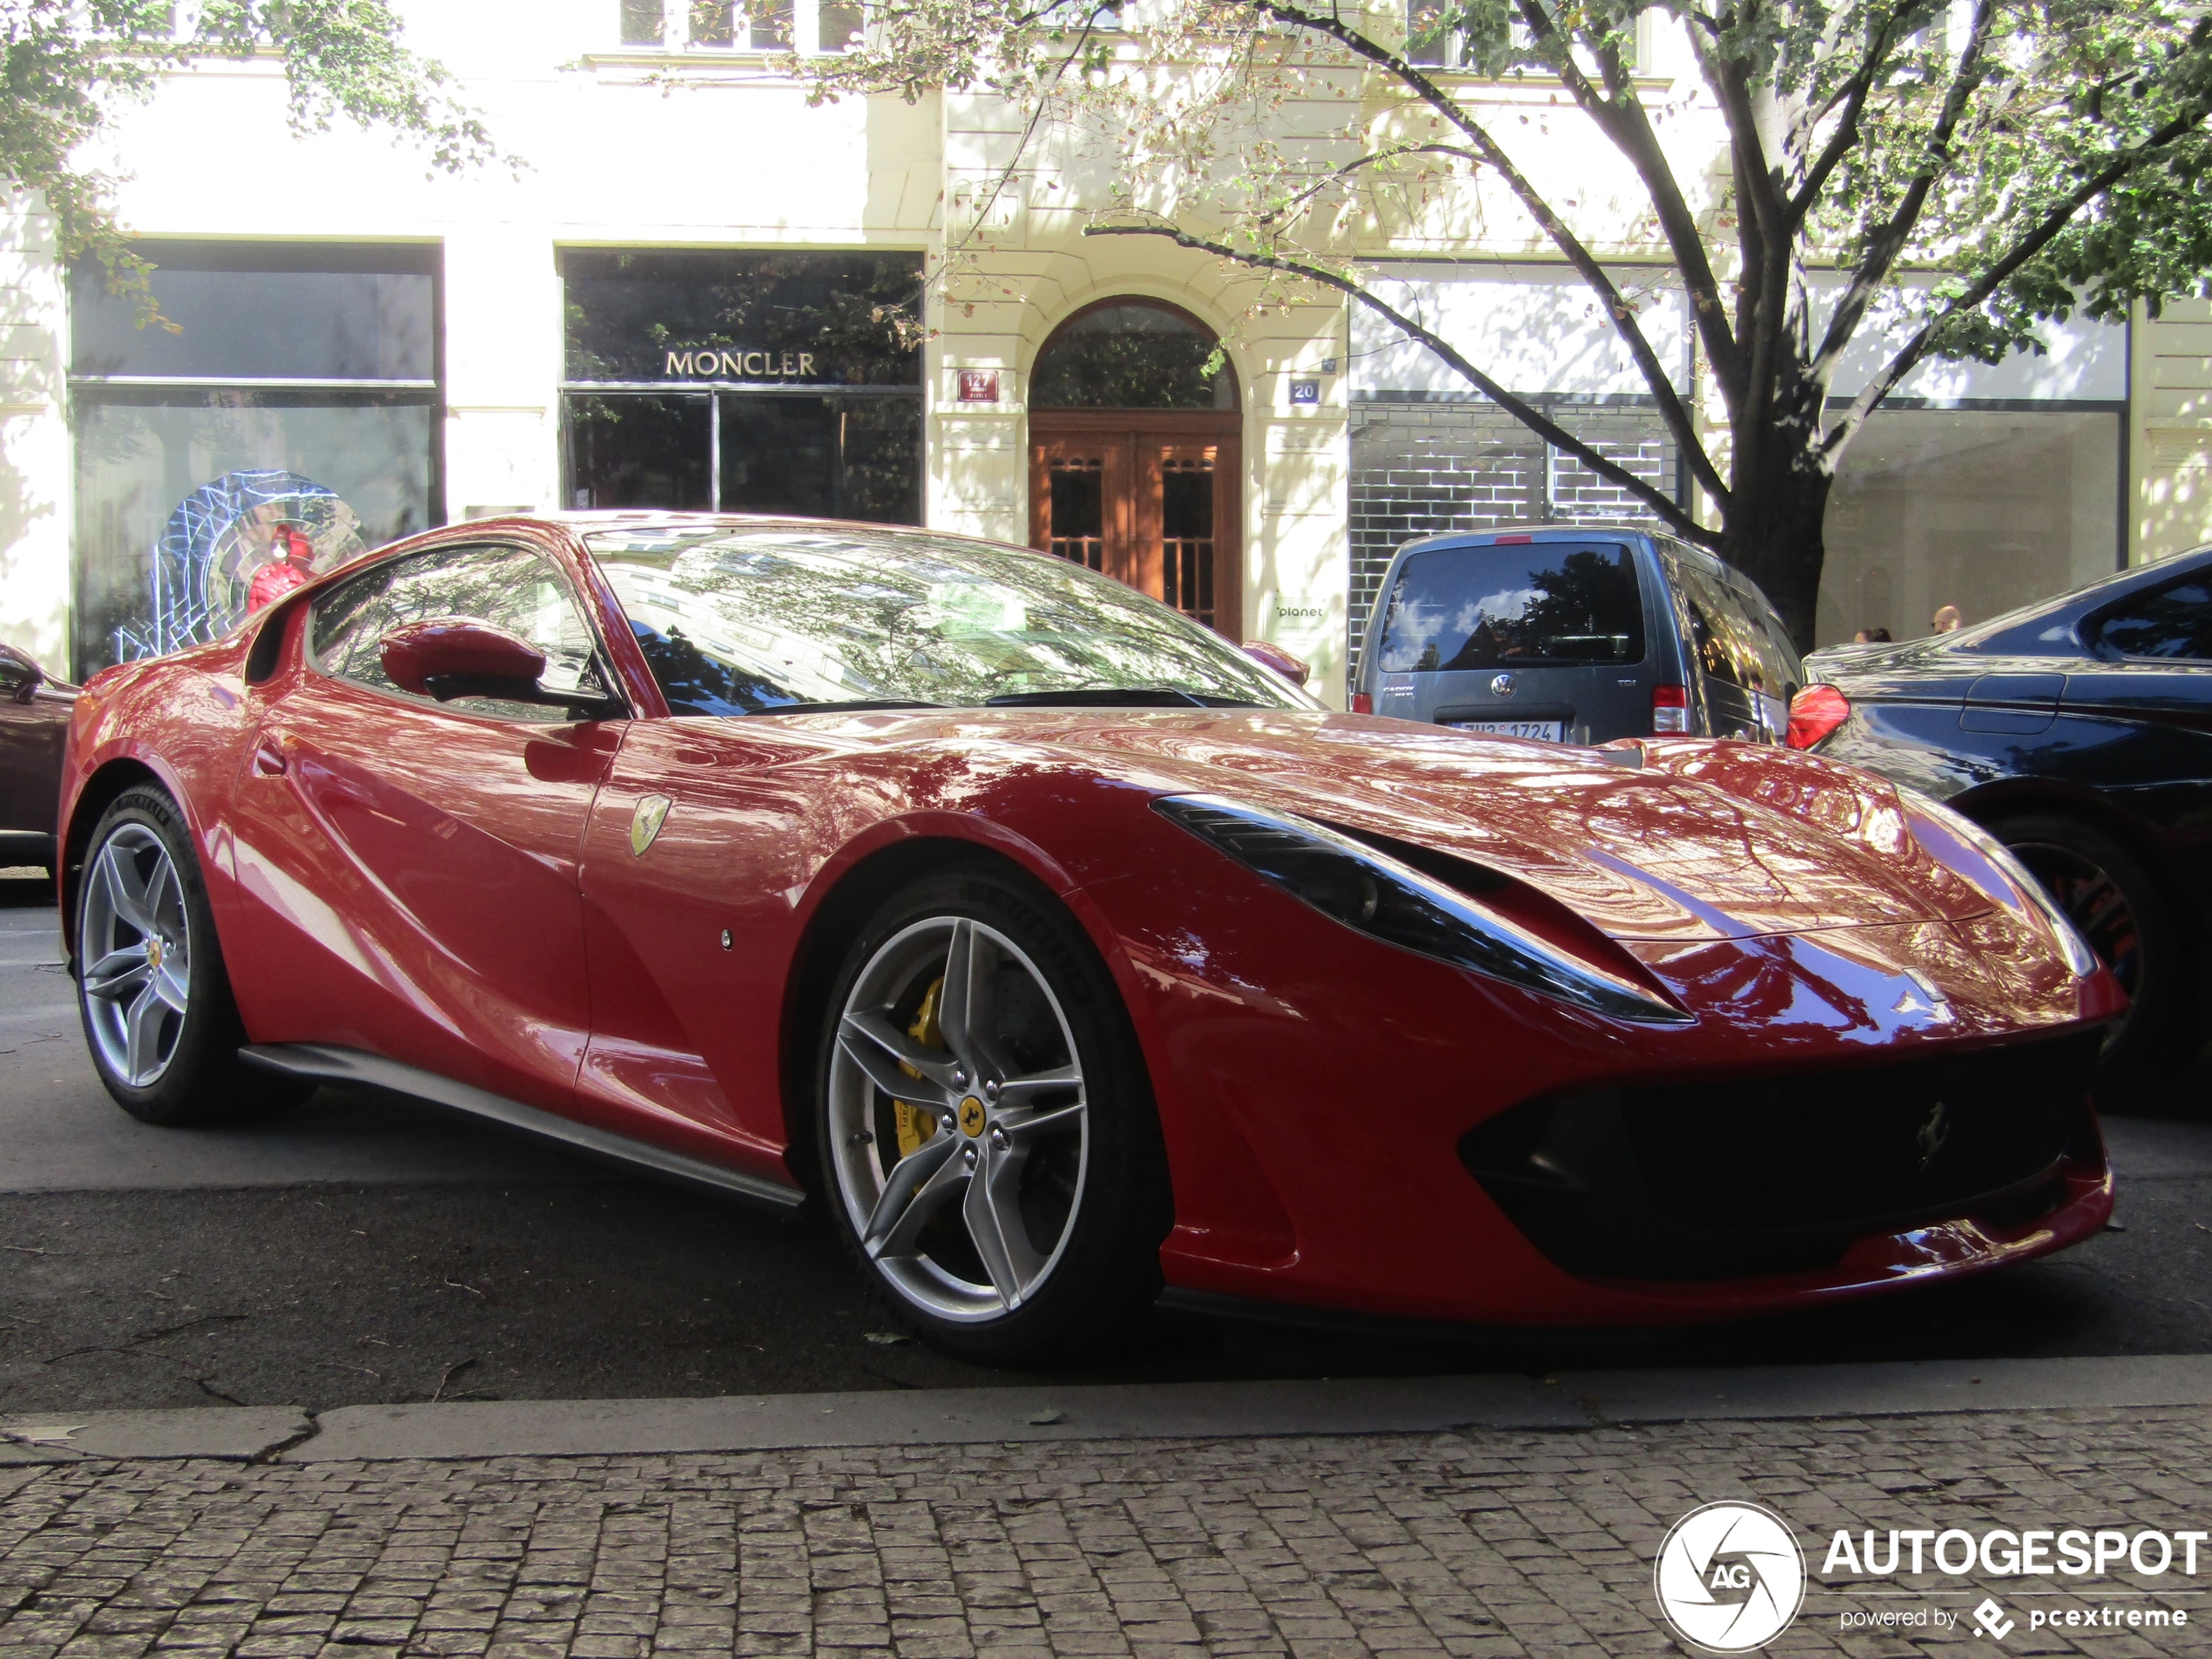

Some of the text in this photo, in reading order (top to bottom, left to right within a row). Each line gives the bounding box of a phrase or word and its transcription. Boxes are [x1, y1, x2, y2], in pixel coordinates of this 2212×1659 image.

[666, 351, 818, 376] MONCLER
[967, 374, 990, 387] 127
[1295, 385, 1313, 398] 20
[1278, 606, 1323, 617] planet
[1509, 724, 1551, 741] 1724
